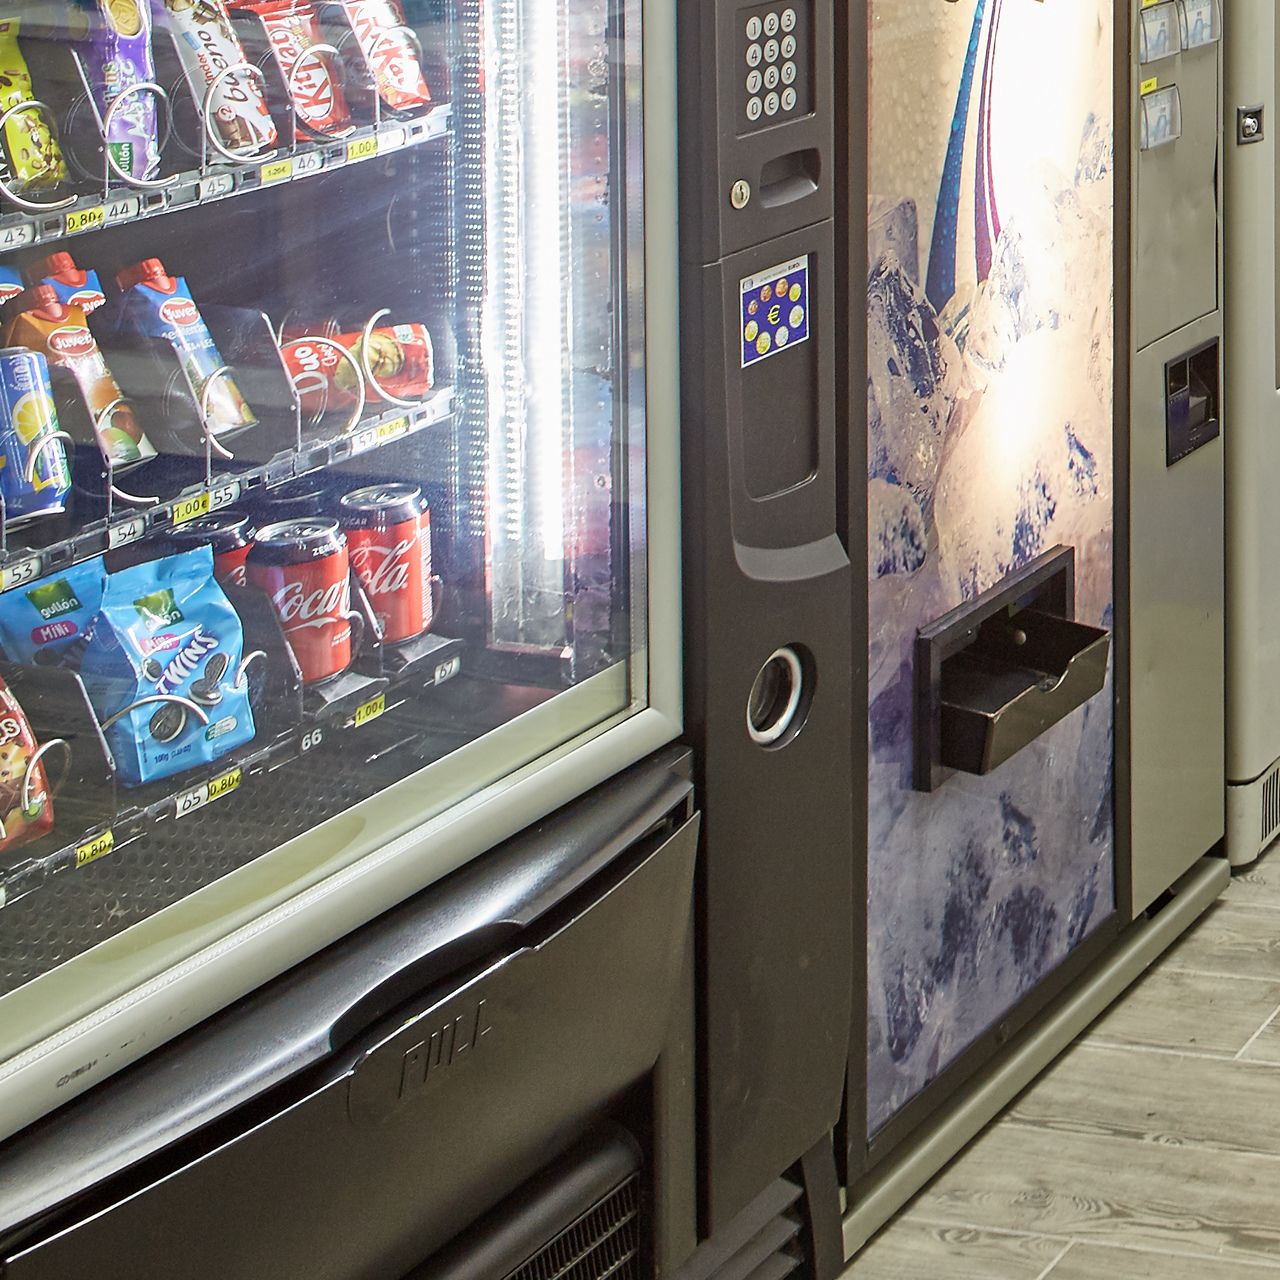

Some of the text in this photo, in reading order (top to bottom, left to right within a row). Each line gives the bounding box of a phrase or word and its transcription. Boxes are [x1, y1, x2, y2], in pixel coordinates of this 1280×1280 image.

[752, 22, 757, 32] 1
[768, 17, 775, 31] 2
[785, 14, 792, 27] 3
[751, 48, 758, 61] 4
[768, 44, 776, 58] 5
[785, 40, 792, 53] 6
[197, 29, 249, 104] bueno
[785, 66, 792, 79] 9
[751, 75, 758, 89] 7
[768, 70, 776, 84] 8
[298, 156, 317, 170] 46
[206, 178, 226, 195] 45
[109, 202, 130, 217] 44
[4, 227, 26, 245] 43
[358, 433, 374, 447] 57
[213, 489, 233, 504] 55
[175, 500, 208, 519] 1.00€
[117, 524, 137, 542] 54
[12, 564, 33, 583] 53
[39, 598, 79, 619] gullón
[438, 661, 455, 678] 67
[356, 700, 385, 724] 1.00€
[301, 728, 323, 751] 66
[210, 773, 241, 797] 0.80€
[181, 791, 202, 810] 65
[78, 838, 114, 863] 0.80€
